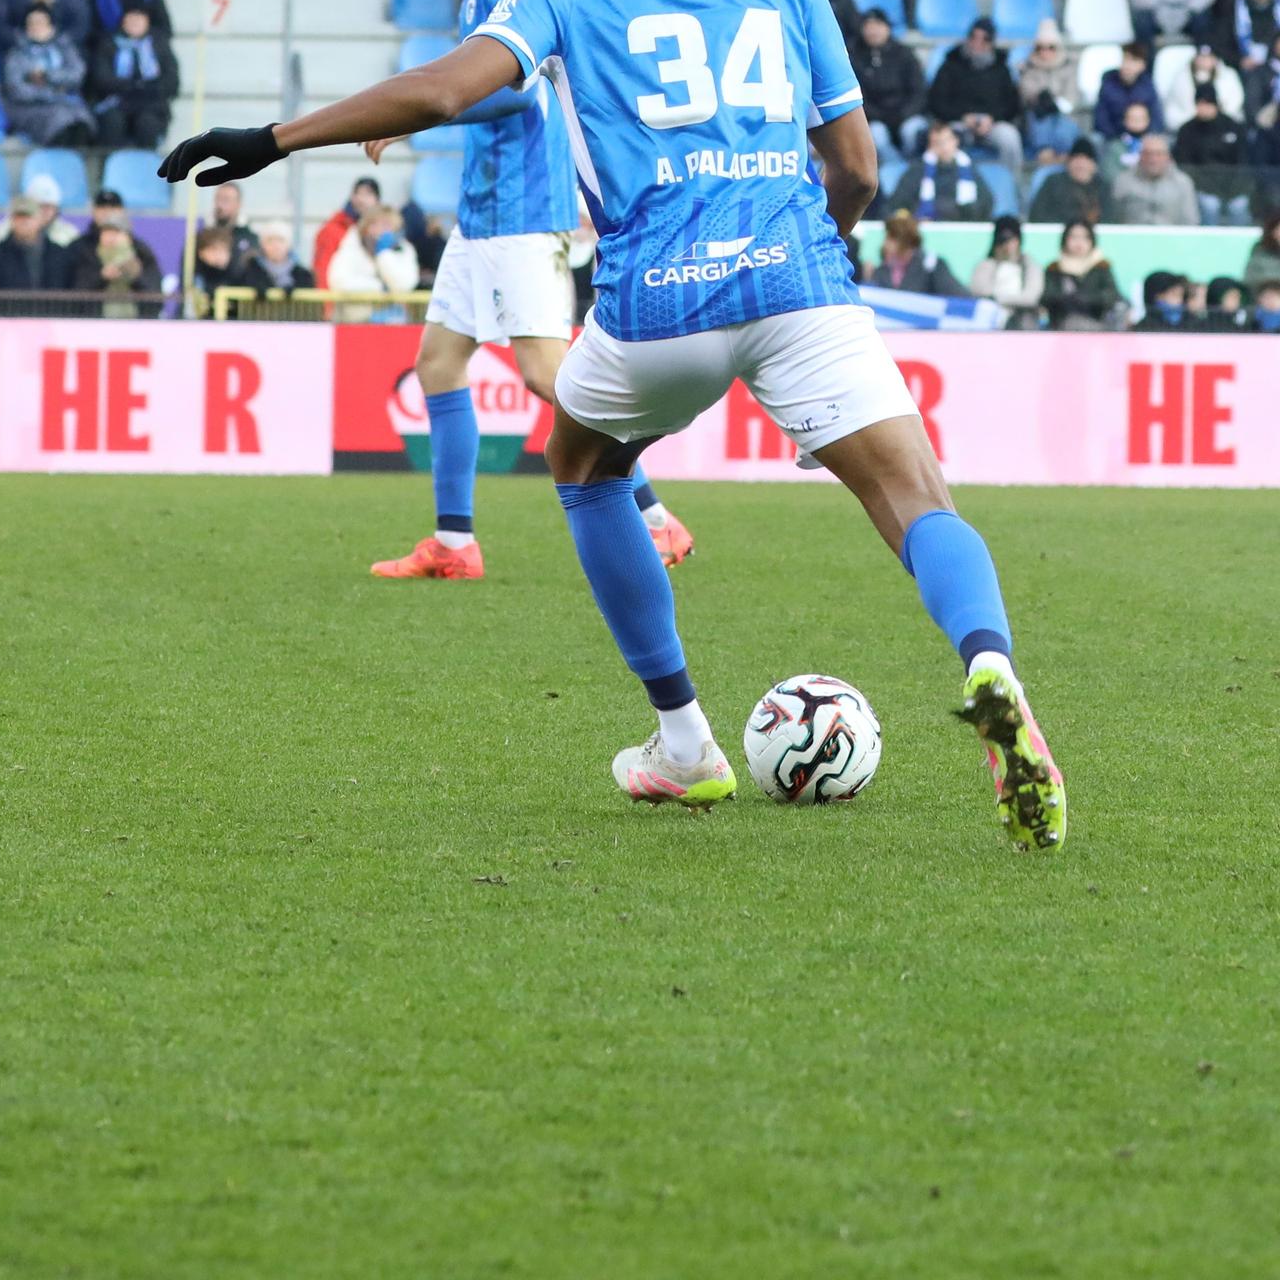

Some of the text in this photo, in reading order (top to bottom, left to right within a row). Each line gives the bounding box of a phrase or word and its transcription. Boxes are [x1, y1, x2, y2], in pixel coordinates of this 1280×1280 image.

[627, 7, 793, 130] 34
[656, 150, 799, 186] A. PALACIOS
[644, 246, 787, 287] CARGLASS
